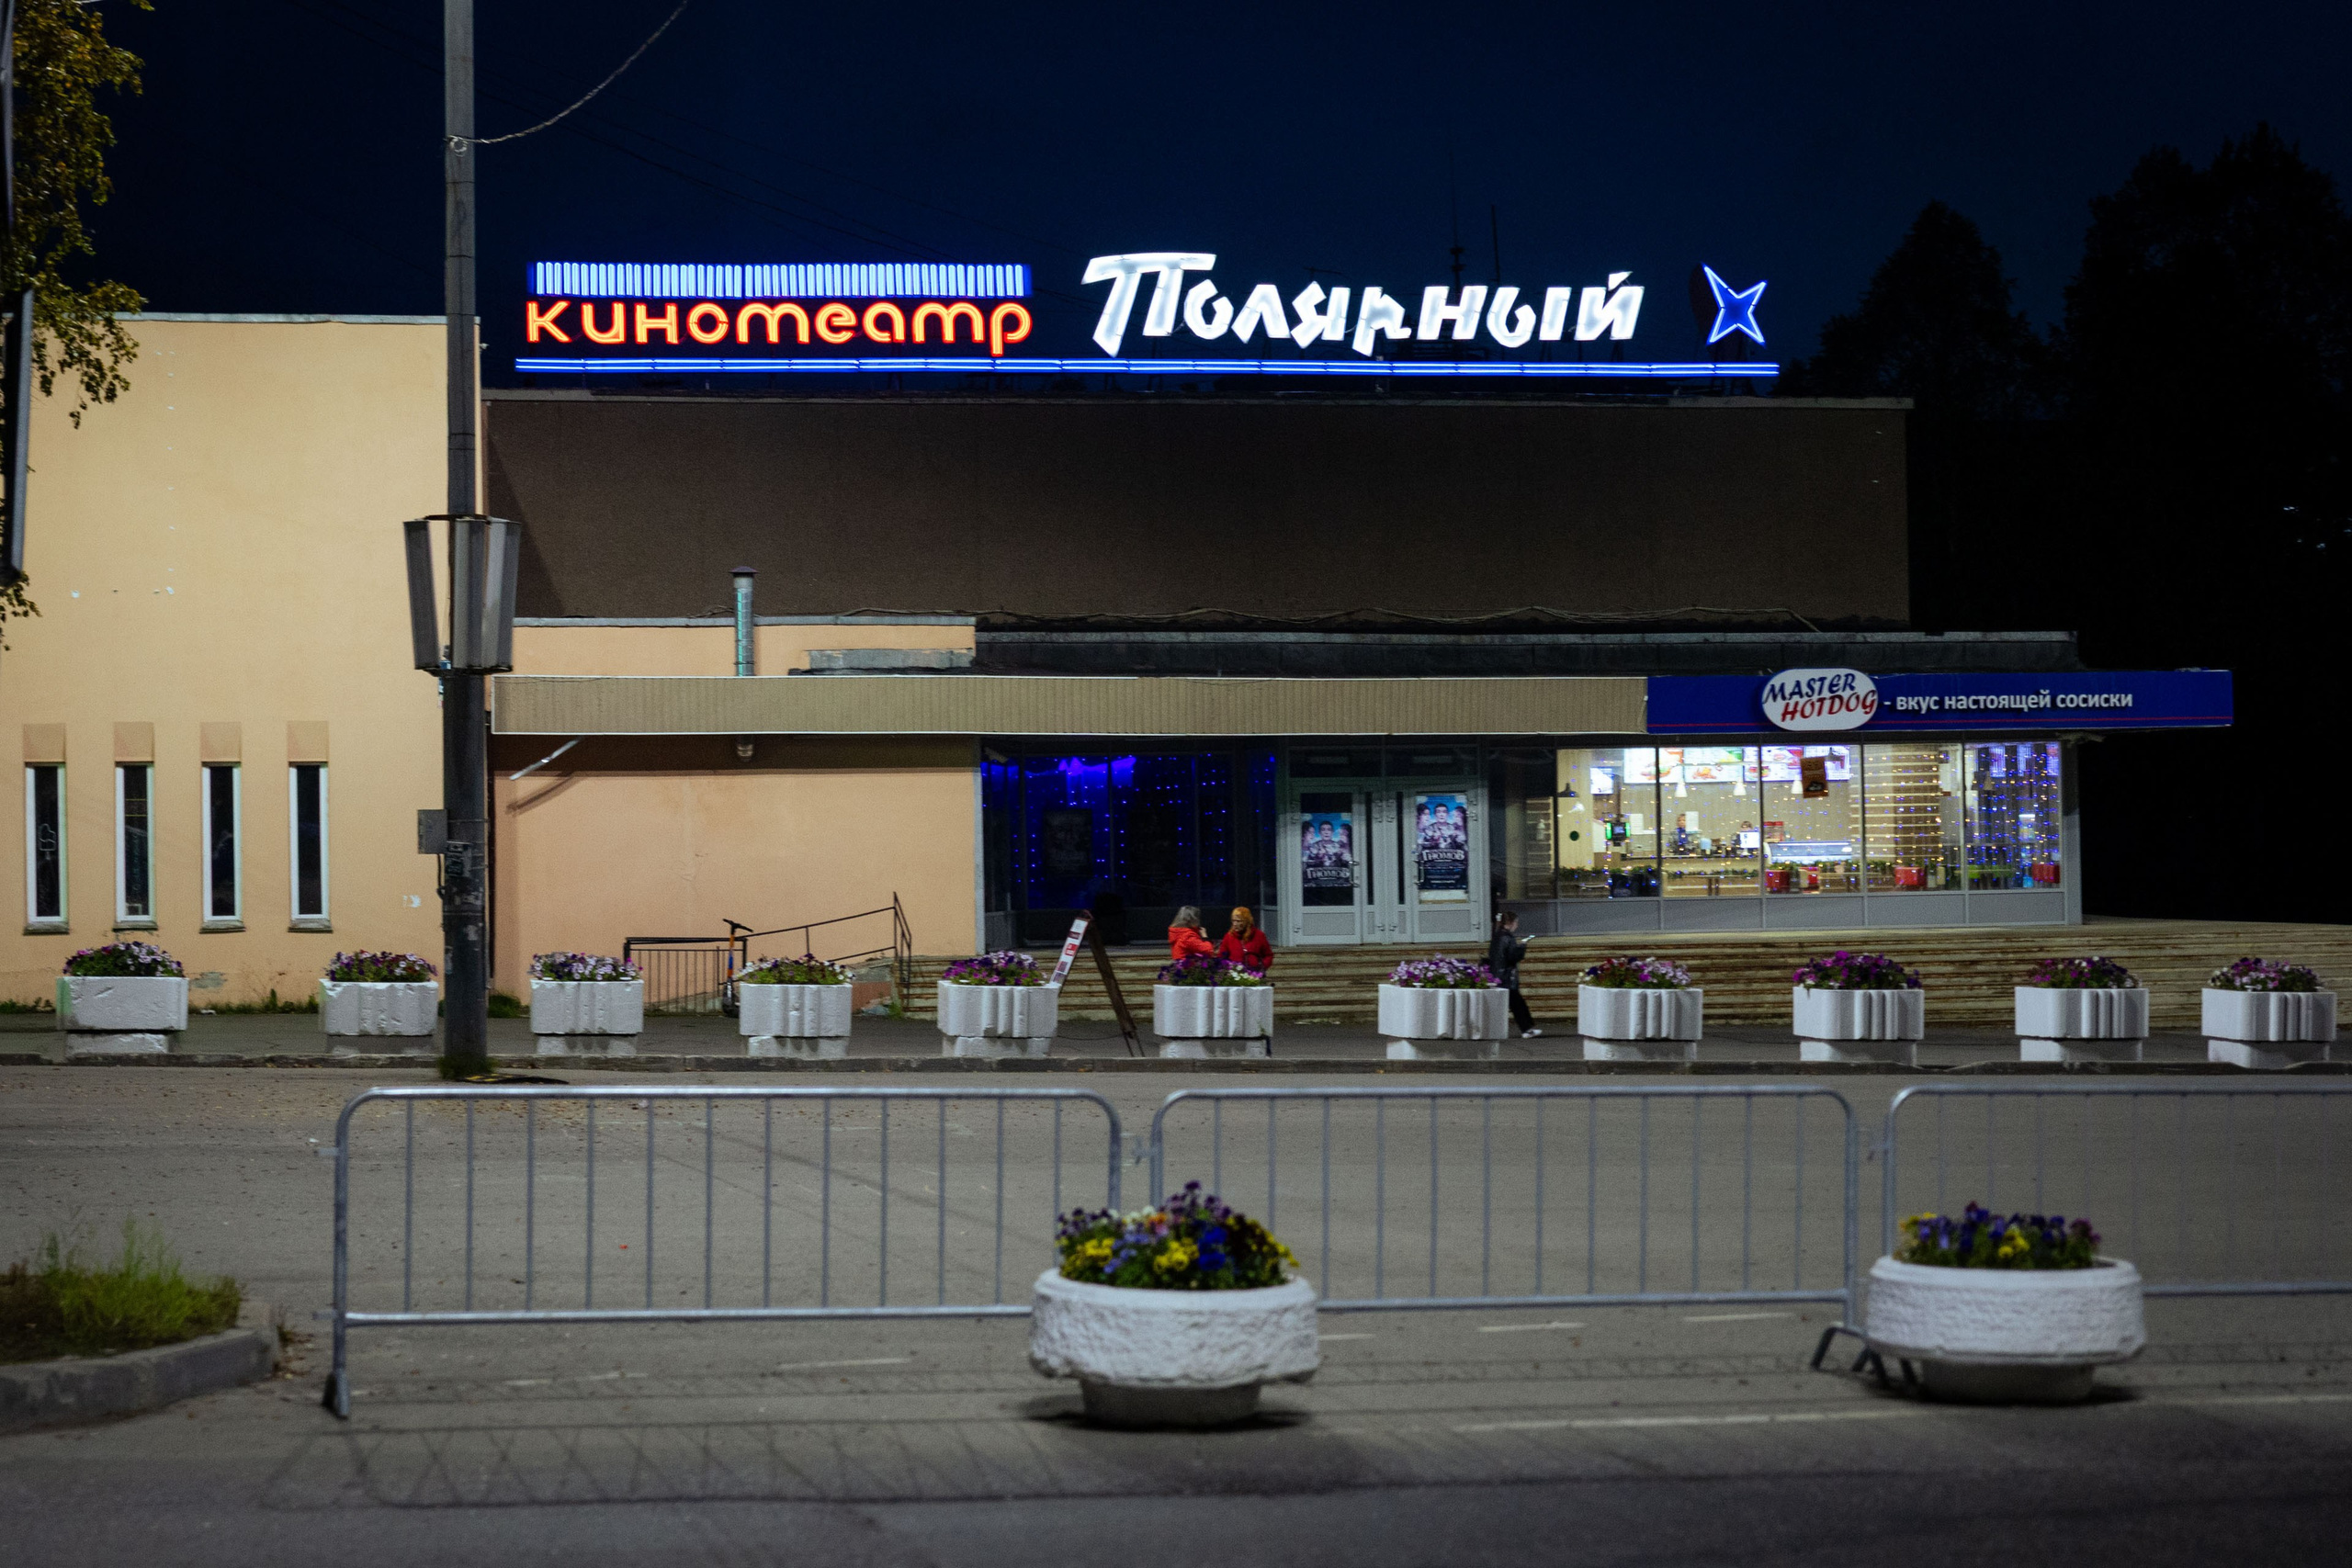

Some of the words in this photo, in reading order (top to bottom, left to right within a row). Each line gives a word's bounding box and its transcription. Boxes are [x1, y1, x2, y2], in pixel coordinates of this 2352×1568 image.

[1081, 252, 1645, 357] Полярный
[1763, 672, 1856, 705] MASTER
[1896, 695, 1939, 715] вкус
[1944, 689, 2051, 712] настоящей
[2056, 694, 2132, 708] сосиски
[1781, 689, 1876, 722] HOTDOG
